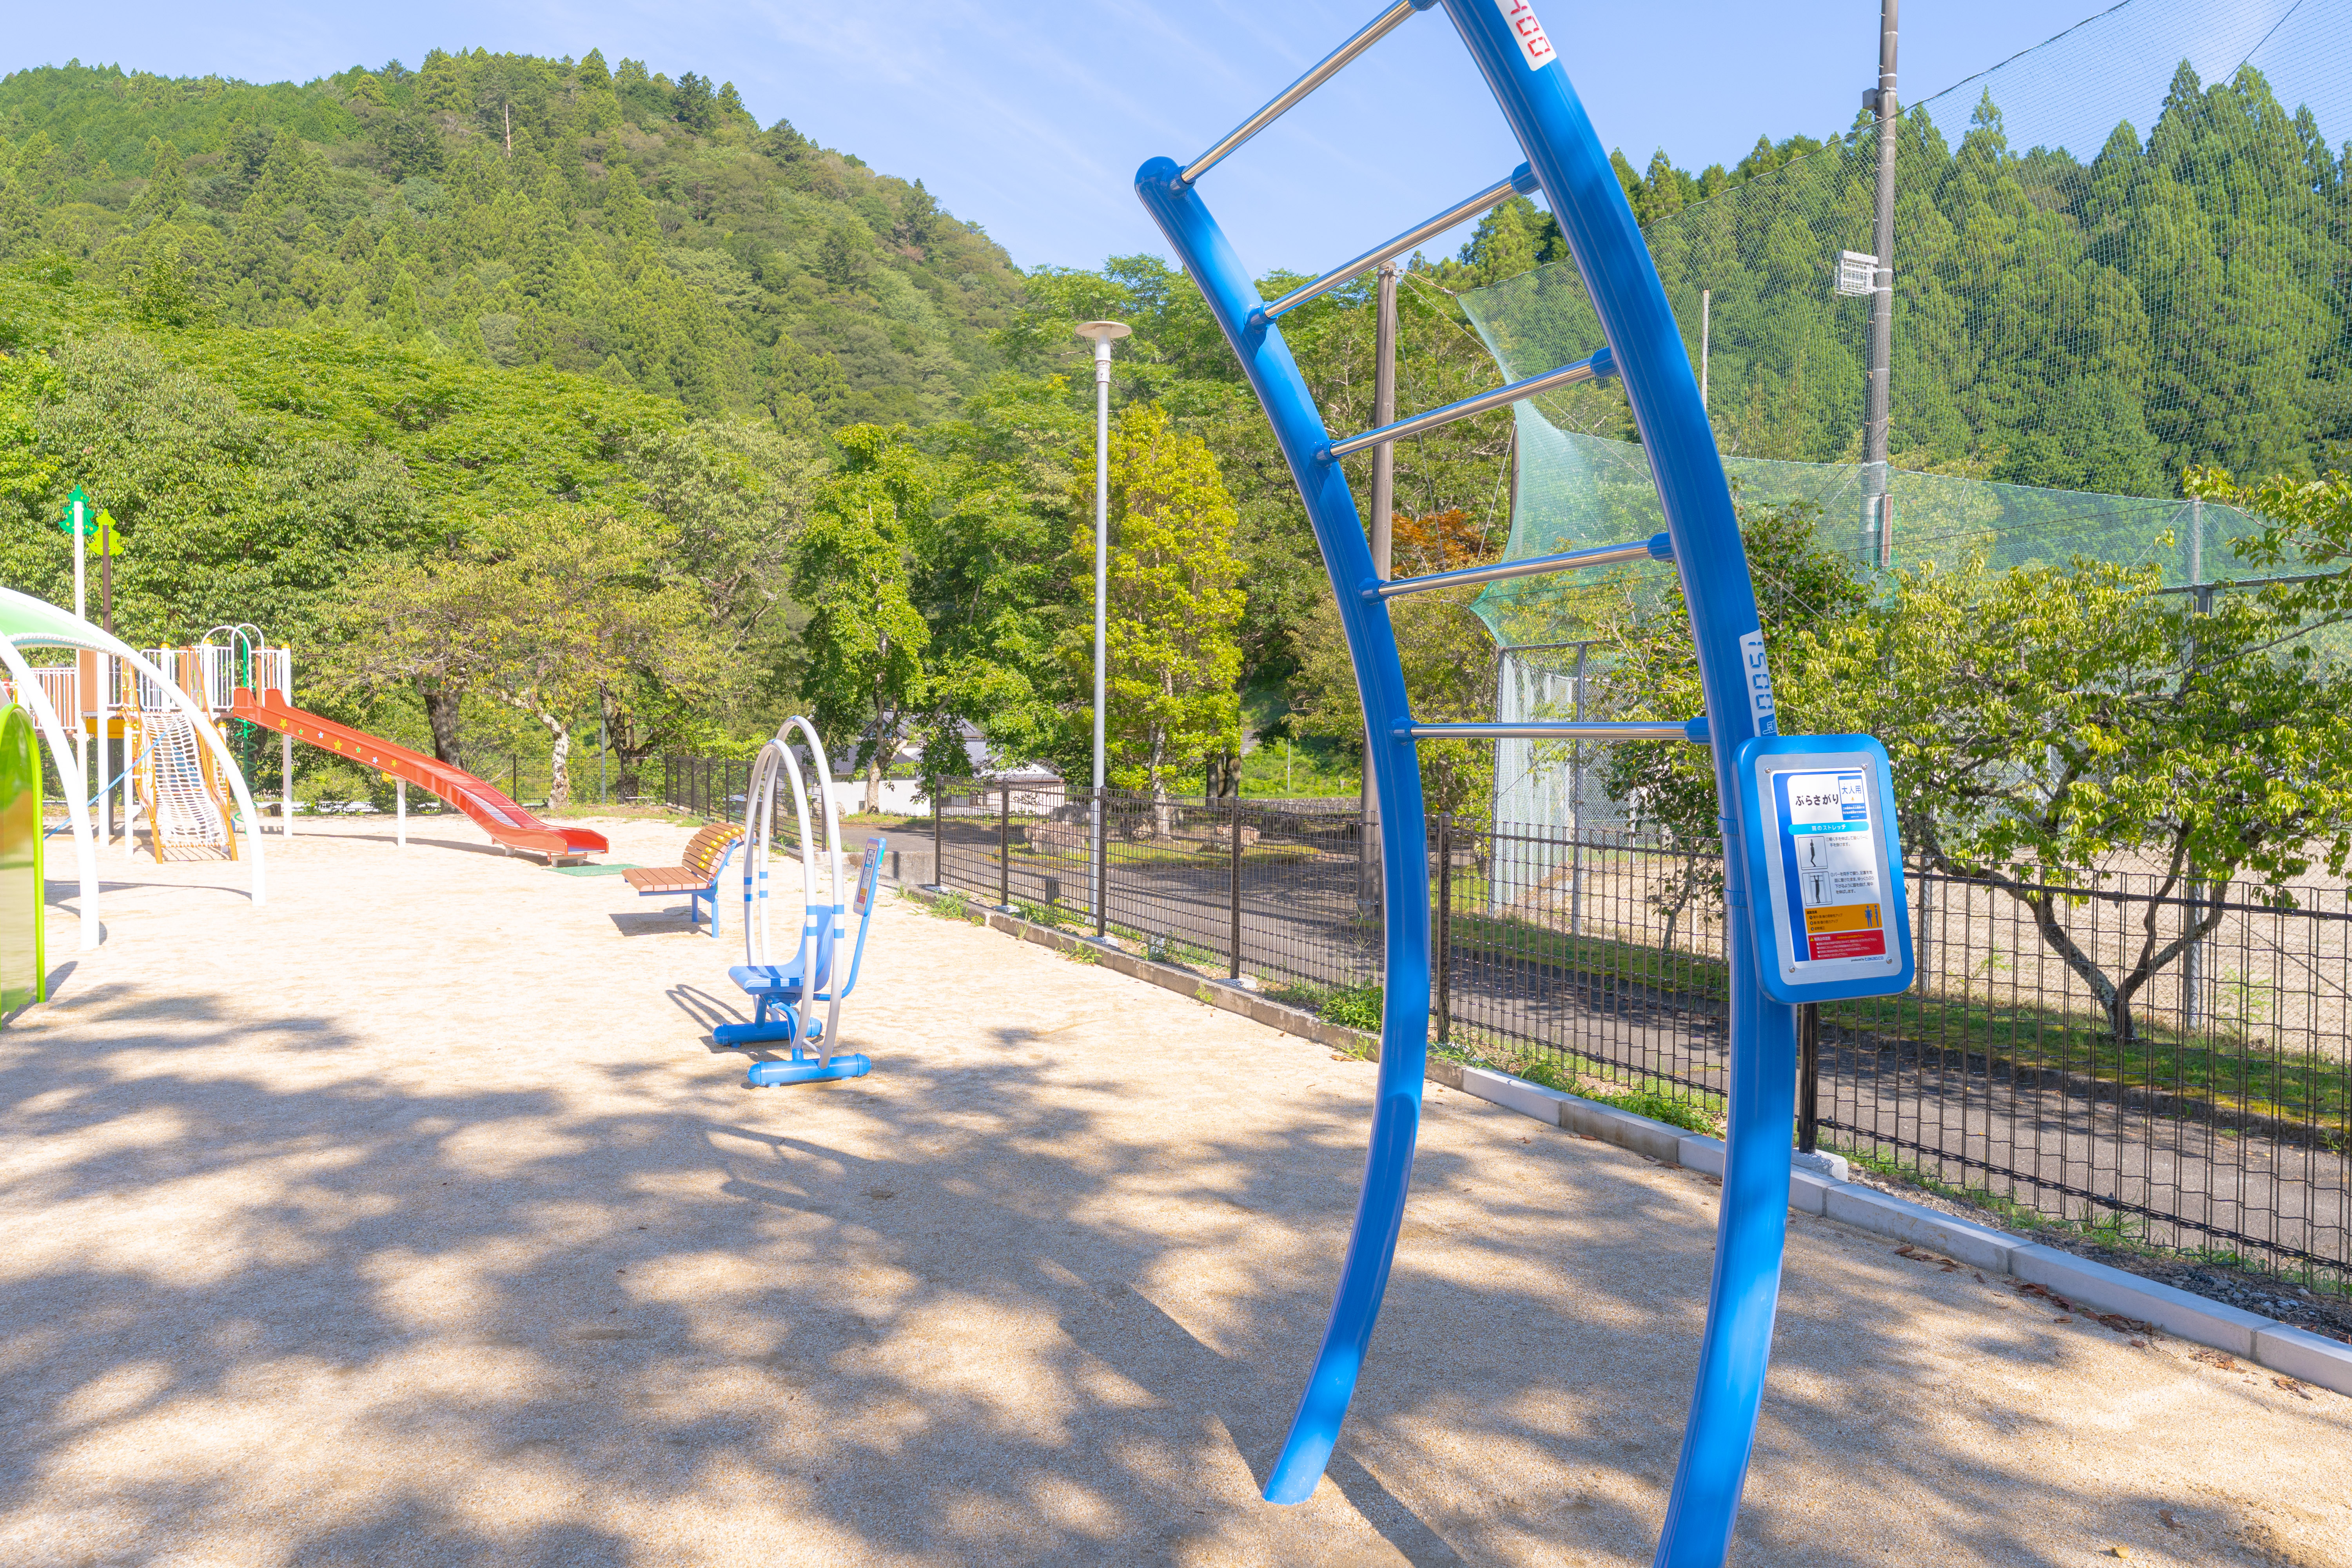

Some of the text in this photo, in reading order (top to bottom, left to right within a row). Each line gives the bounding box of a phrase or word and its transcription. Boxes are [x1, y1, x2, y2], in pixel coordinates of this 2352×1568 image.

[1748, 641, 1773, 710] 1500
[1842, 786, 1861, 794] 大人用
[1795, 794, 1839, 806] ぶらさがり
